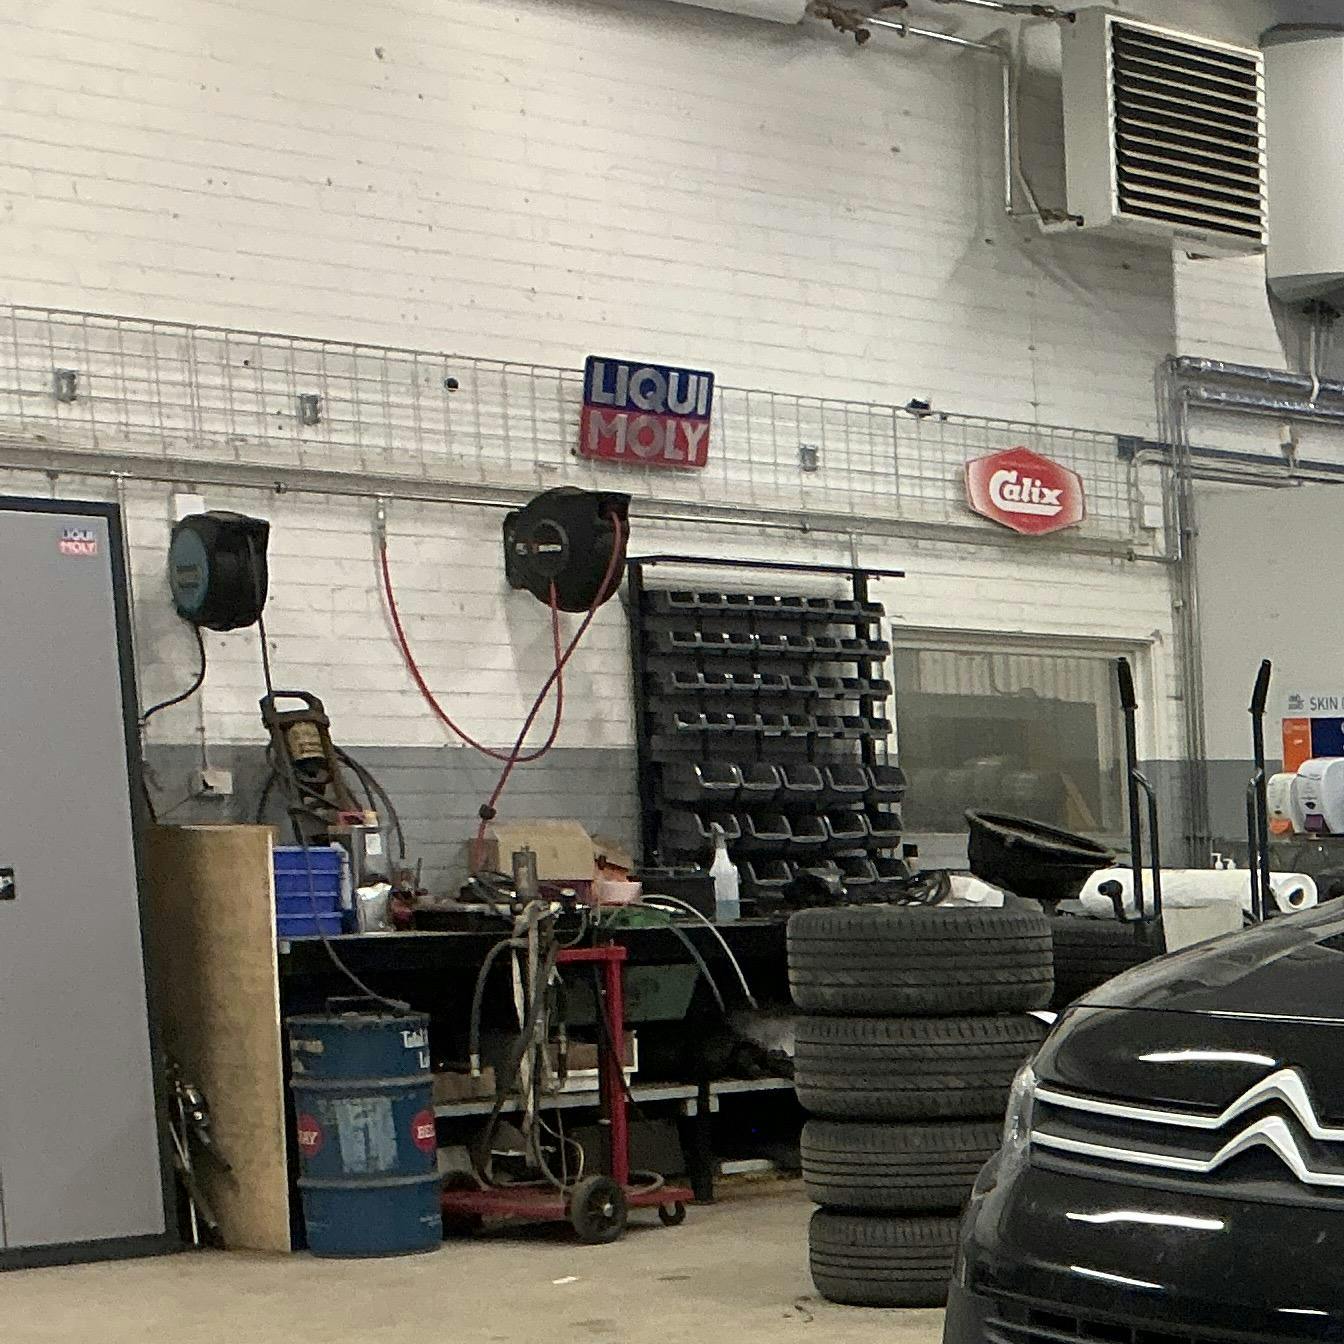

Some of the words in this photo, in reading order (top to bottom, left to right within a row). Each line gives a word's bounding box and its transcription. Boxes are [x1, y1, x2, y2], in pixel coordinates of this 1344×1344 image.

[590, 362, 709, 416] LIQUI
[588, 410, 709, 462] MOLY
[988, 469, 1063, 516] Calix
[1310, 696, 1338, 711] SKIN
